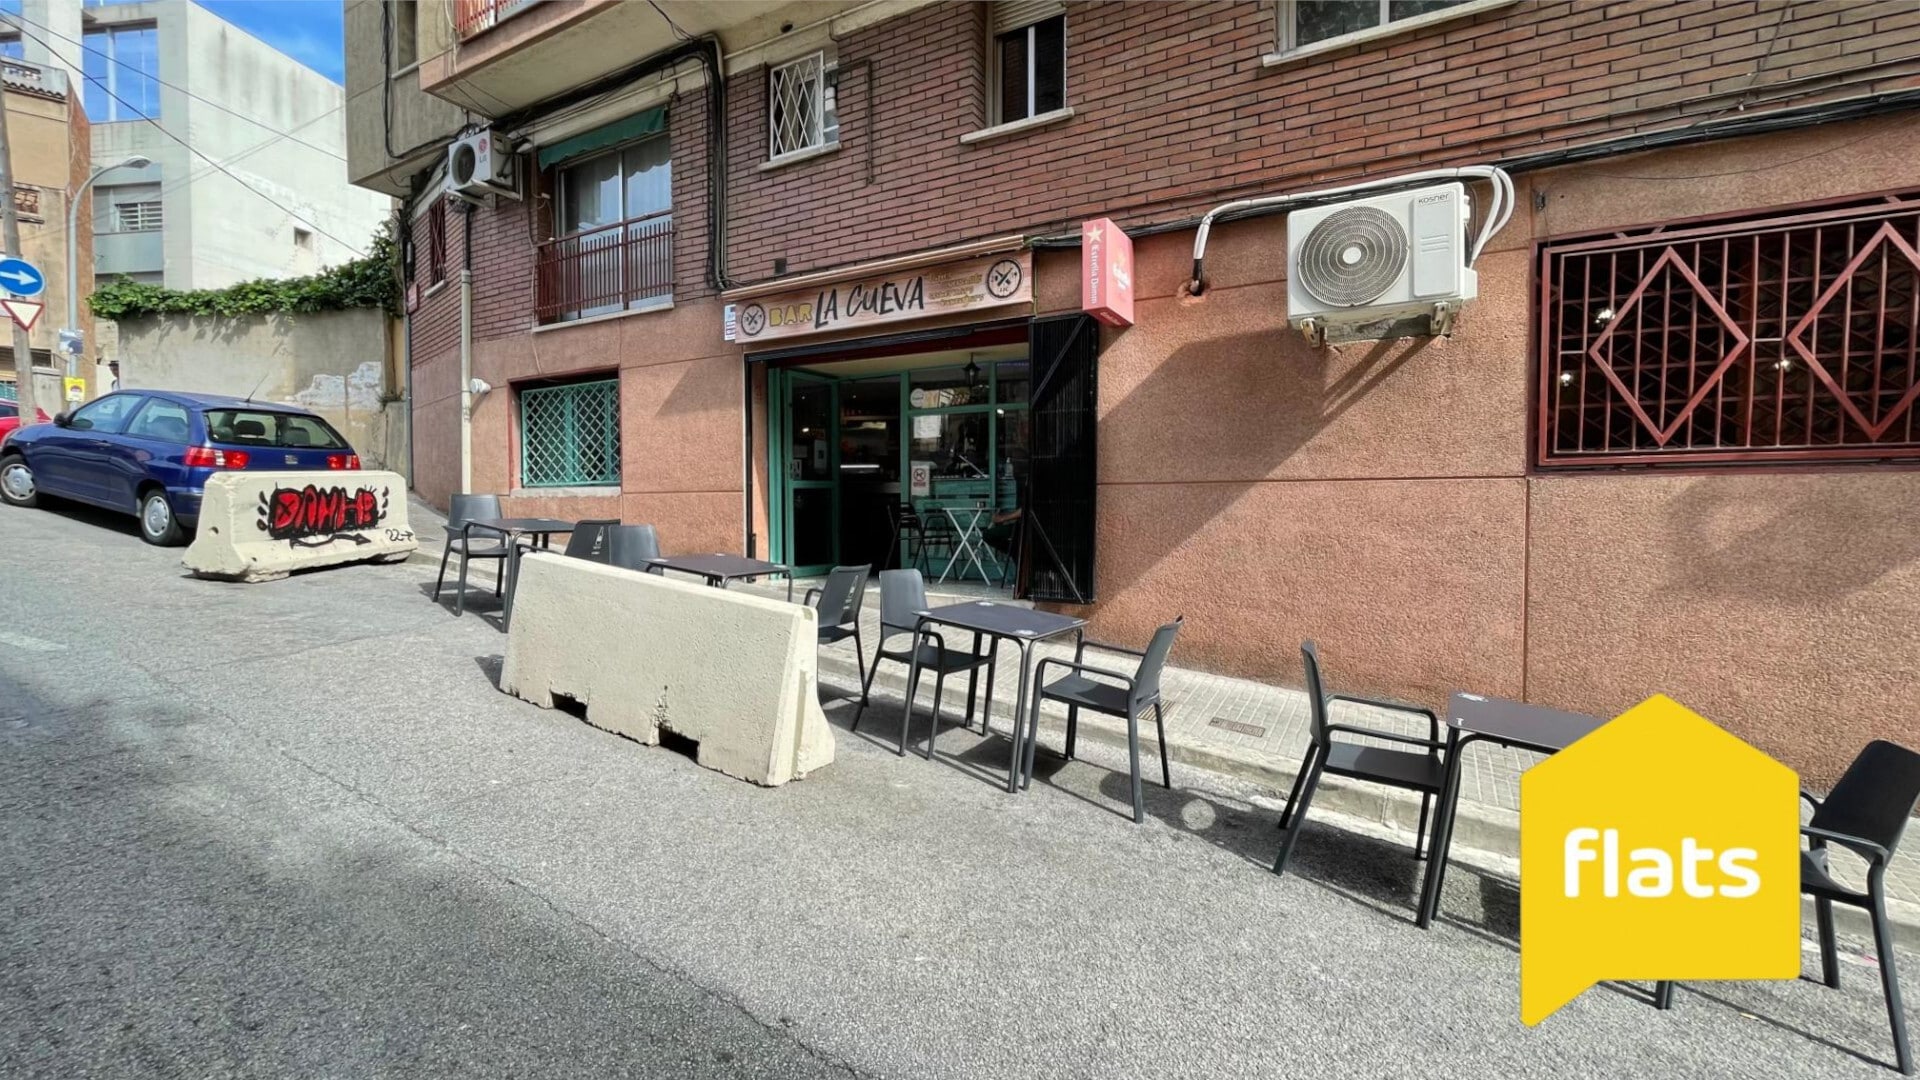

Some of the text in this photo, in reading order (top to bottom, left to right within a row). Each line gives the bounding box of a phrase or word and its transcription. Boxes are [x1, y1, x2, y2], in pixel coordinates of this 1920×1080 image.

[1090, 277, 1099, 305] Damm
[769, 303, 814, 327] BAR
[814, 288, 839, 330] LA
